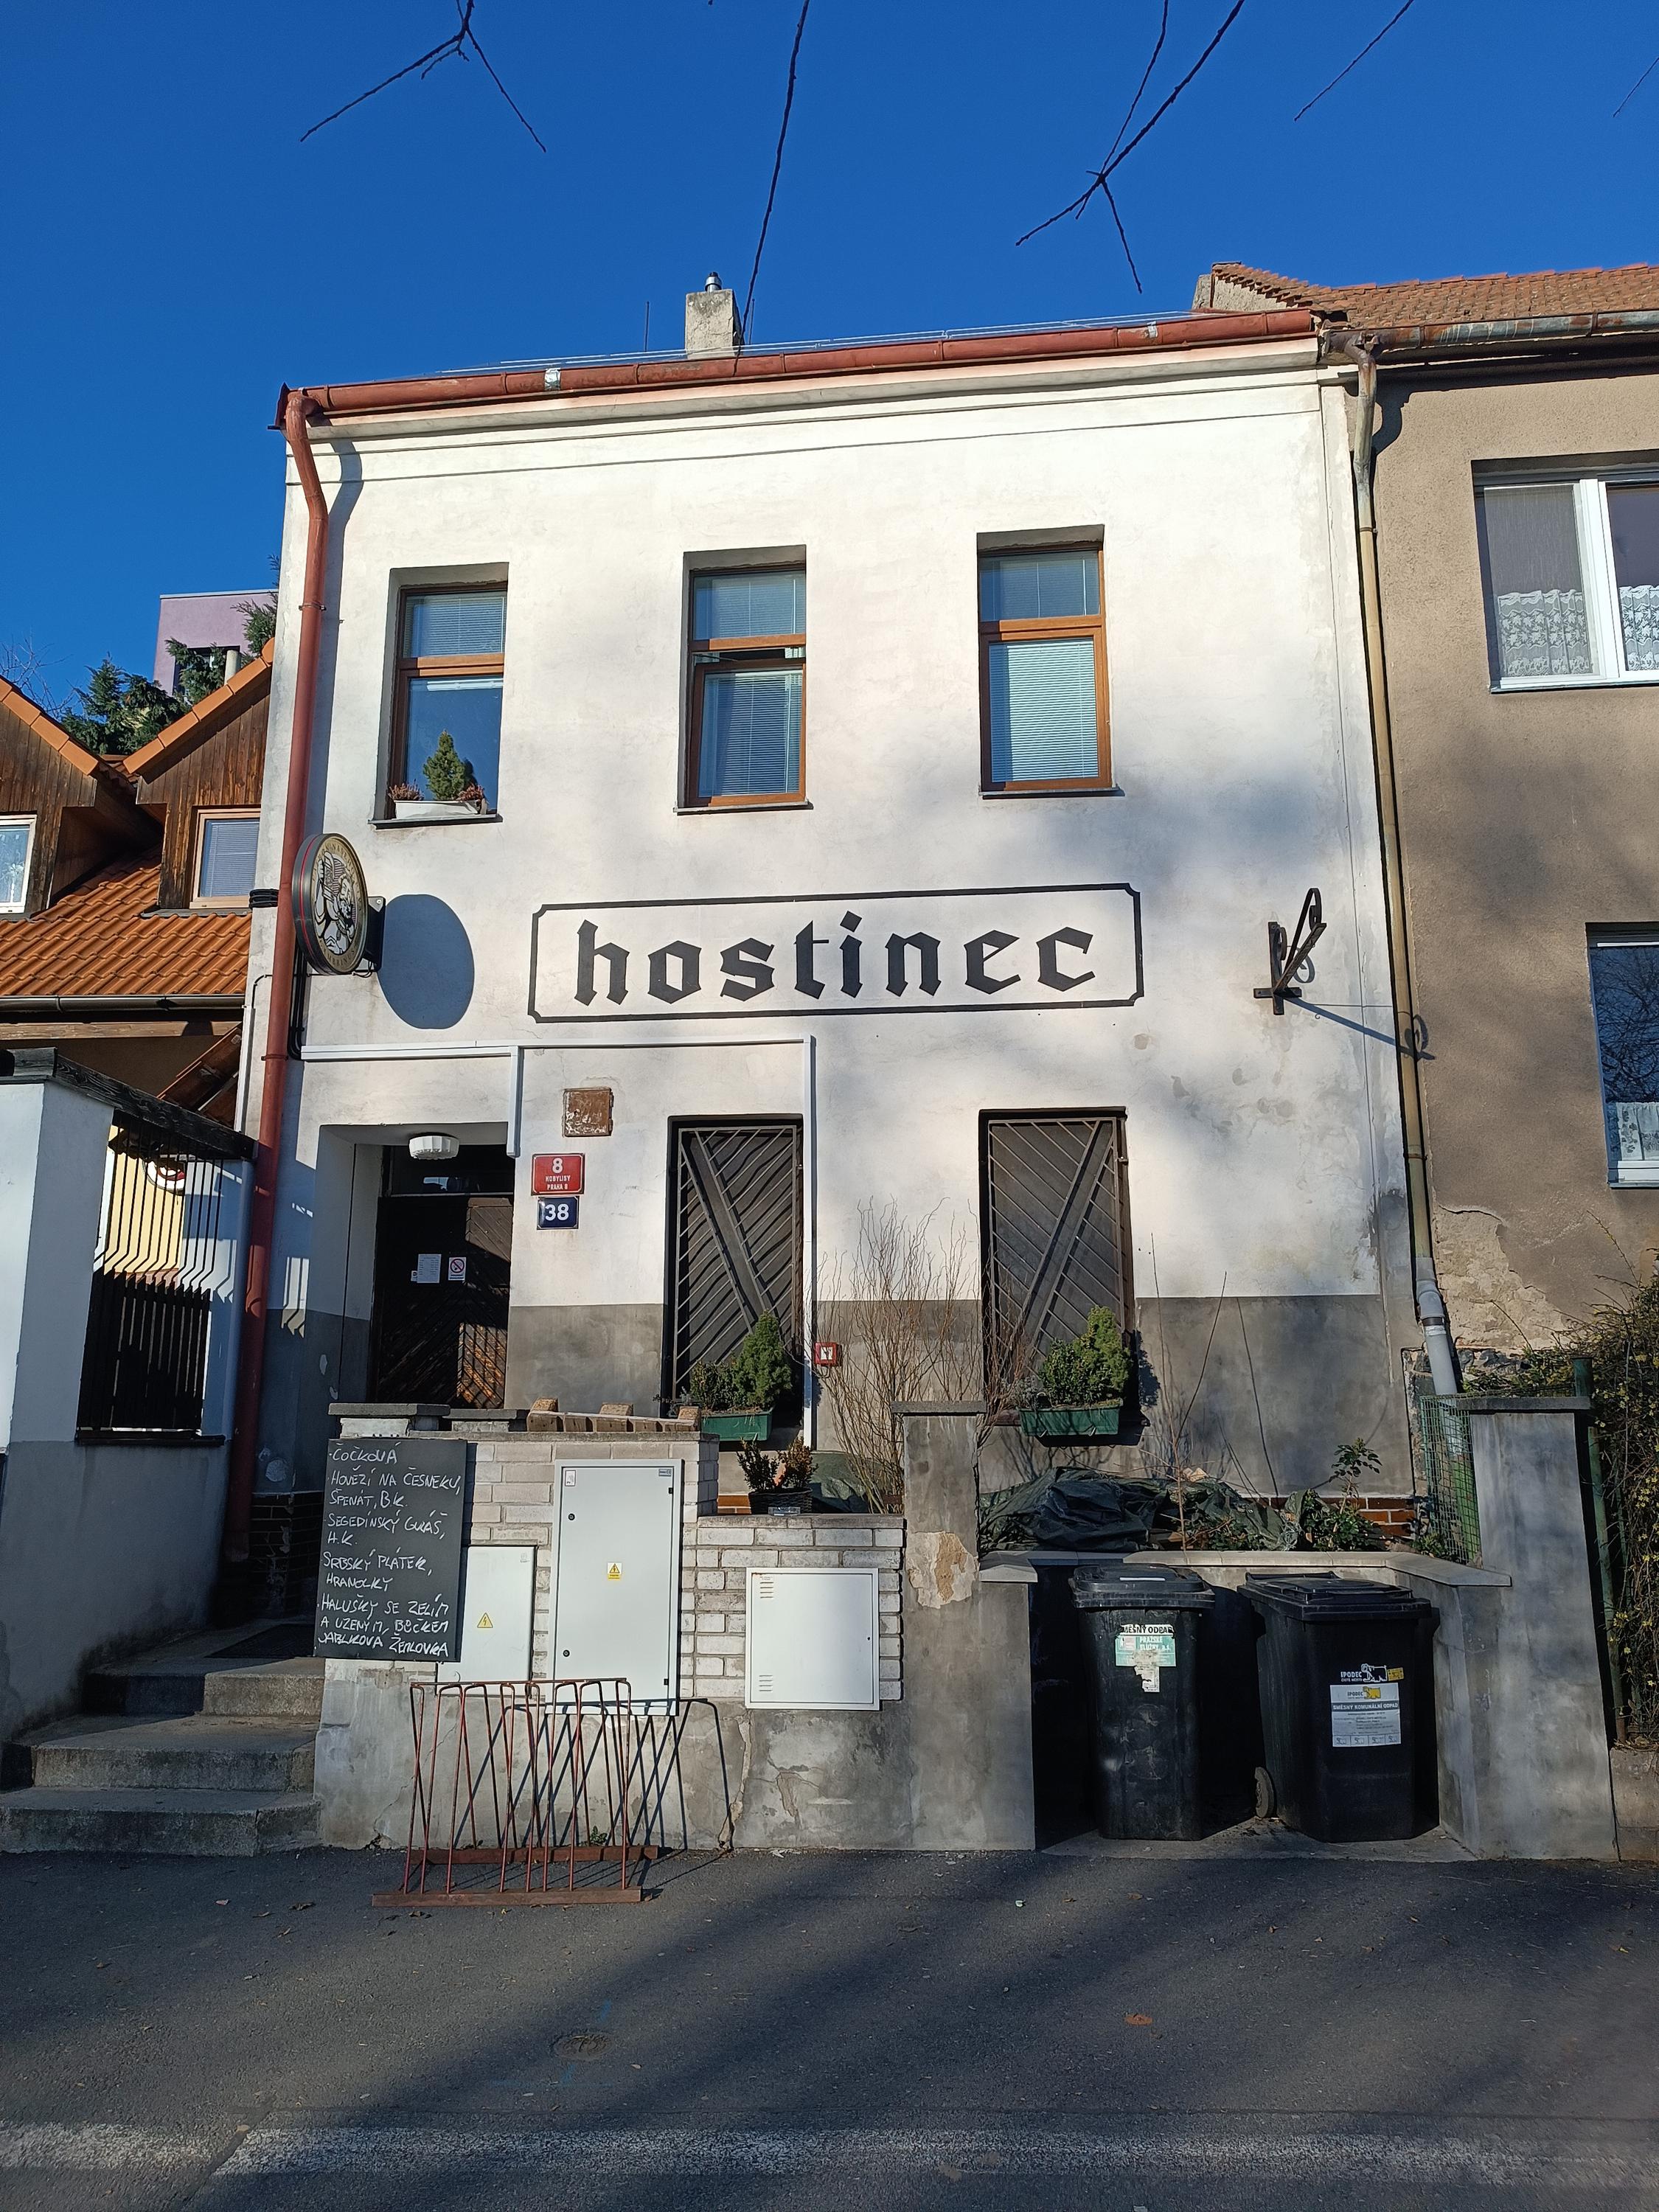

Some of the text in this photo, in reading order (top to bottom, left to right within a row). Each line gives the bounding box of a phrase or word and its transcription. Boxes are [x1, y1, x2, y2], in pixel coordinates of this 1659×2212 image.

[574, 910, 1096, 1006] hostinec
[552, 1158, 563, 1174] 8
[545, 1203, 569, 1221] 38
[333, 1441, 401, 1464] ČOČKOVÁ
[331, 1465, 376, 1486] HOVĚZÍ
[379, 1473, 397, 1486] NA
[323, 1548, 376, 1571] SRBSKÝ
[326, 1573, 394, 1592] HRANOLKY
[321, 1593, 449, 1620] HALUŠKY SE ZELÍM
[320, 1615, 330, 1628] A
